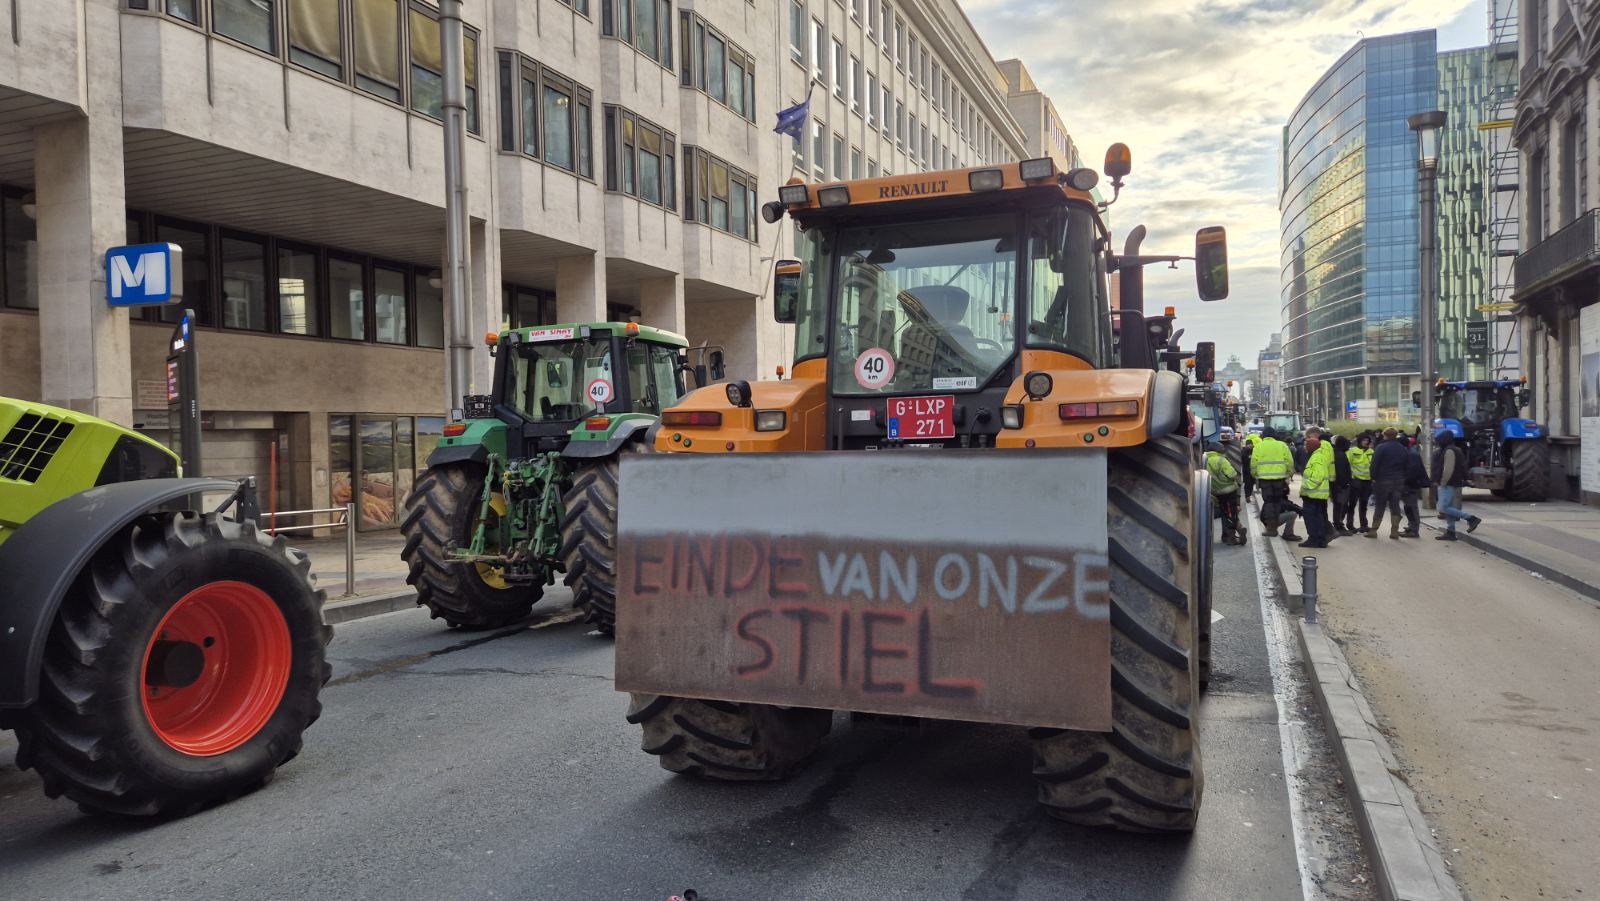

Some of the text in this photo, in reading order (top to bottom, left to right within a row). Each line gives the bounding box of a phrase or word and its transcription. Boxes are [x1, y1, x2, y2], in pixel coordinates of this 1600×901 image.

[880, 180, 949, 198] RENAULT
[111, 251, 167, 298] M
[864, 357, 884, 373] 40
[591, 386, 604, 396] 40
[916, 418, 945, 435] 271
[632, 532, 1109, 618] EINDE VAN ONZE
[734, 606, 979, 698] STIEL
